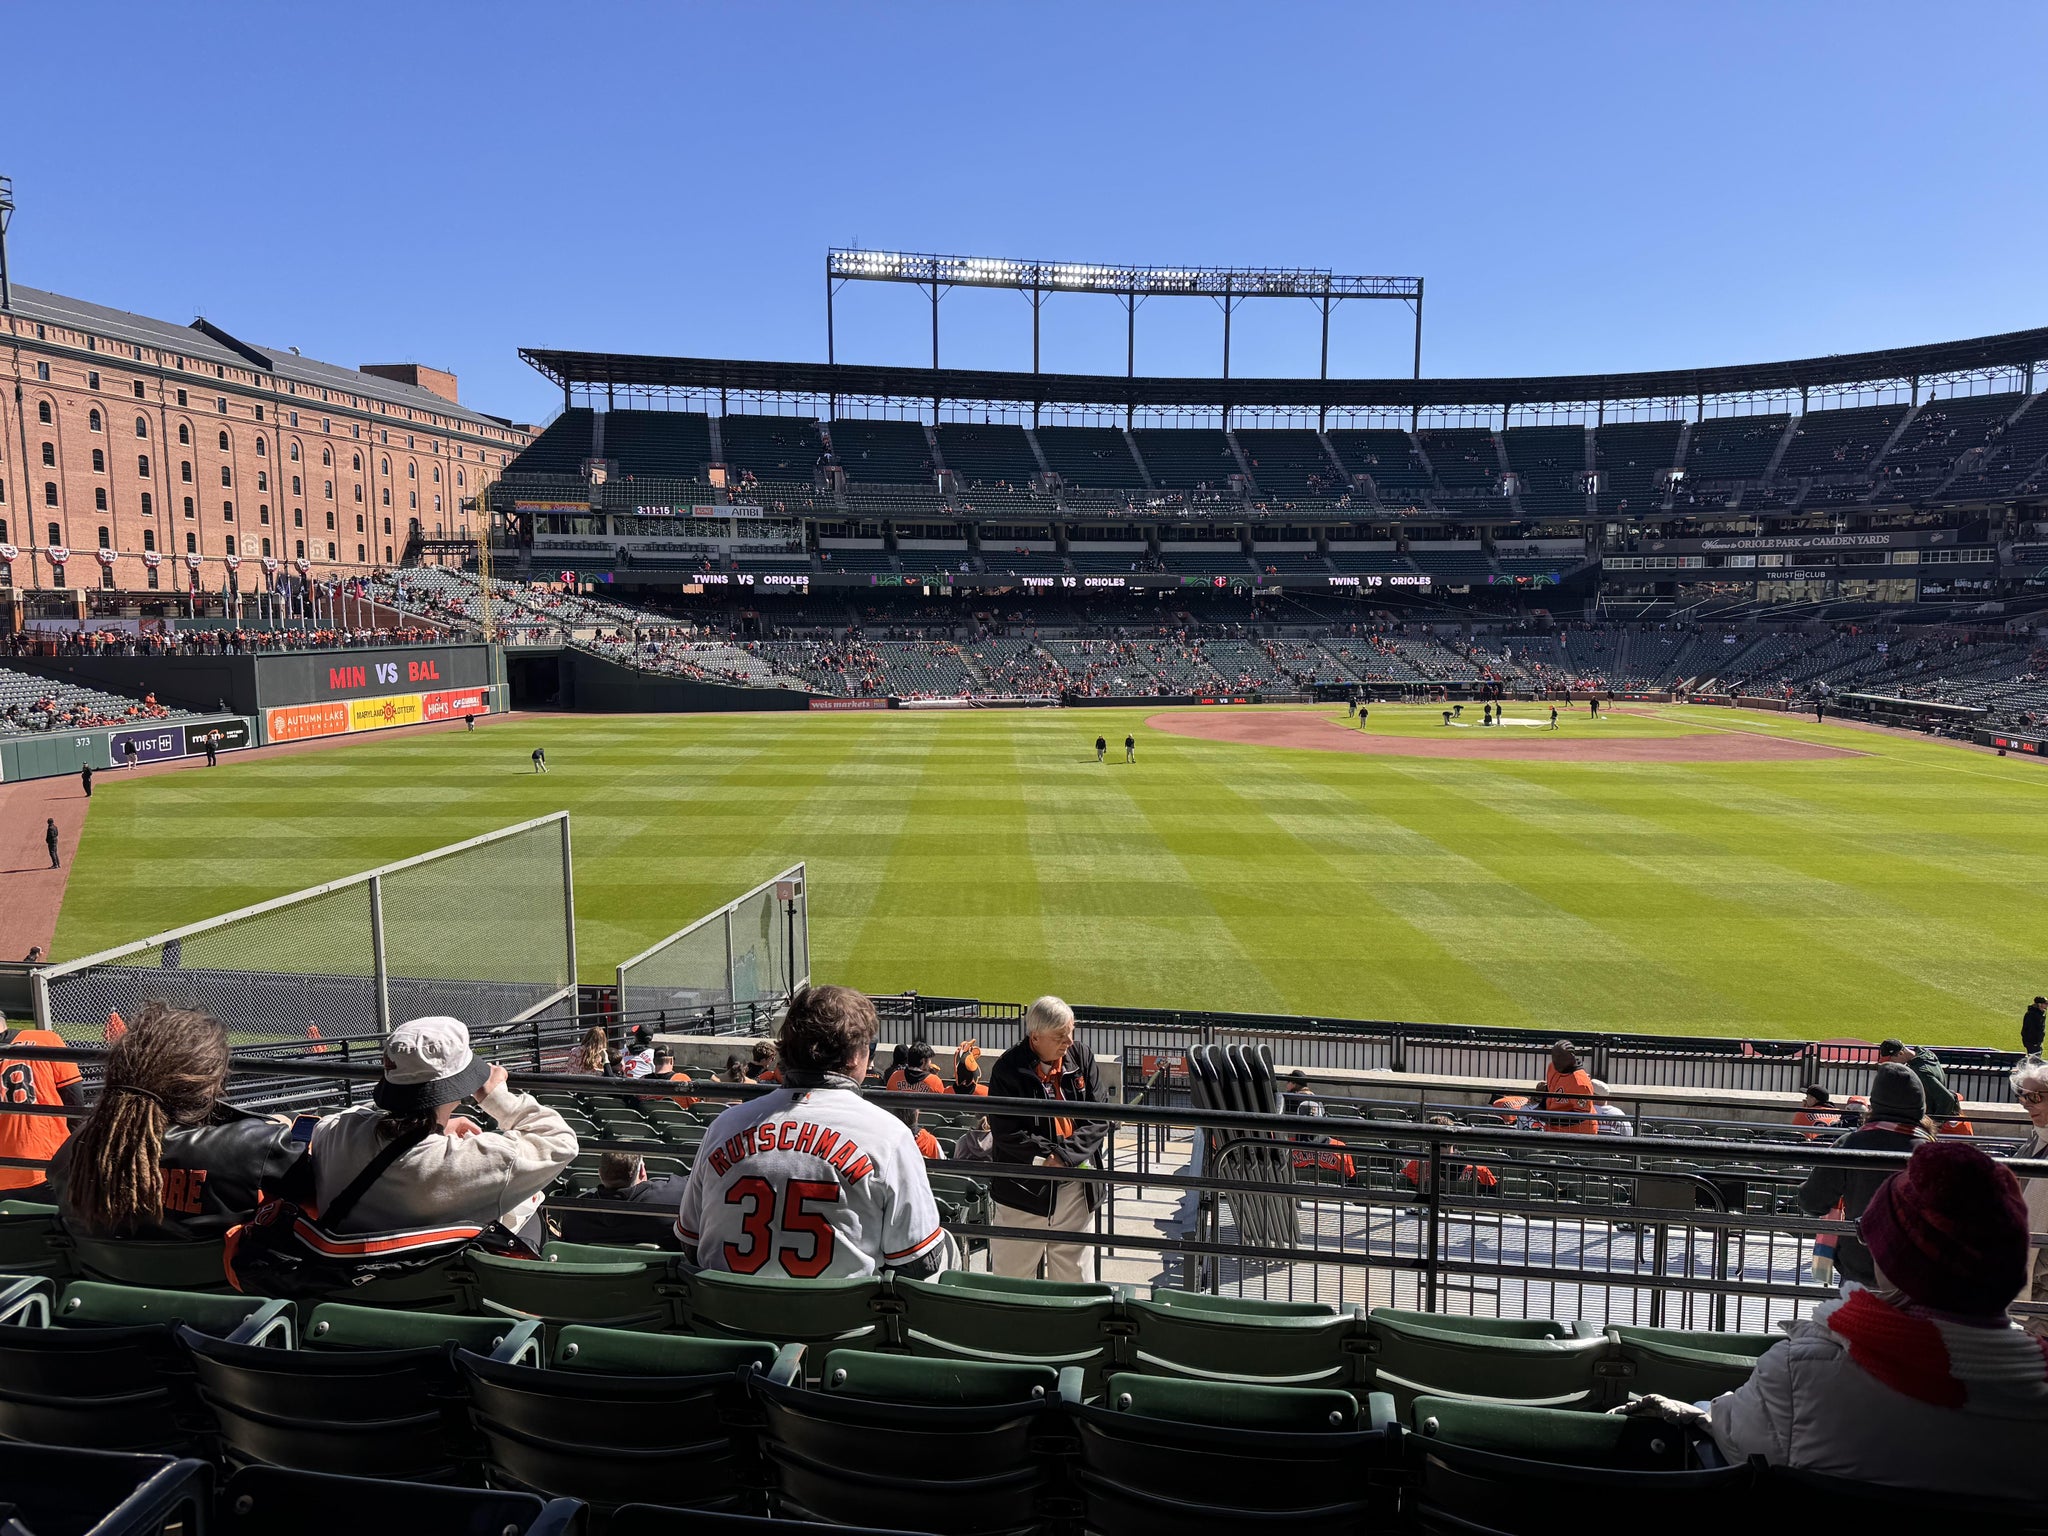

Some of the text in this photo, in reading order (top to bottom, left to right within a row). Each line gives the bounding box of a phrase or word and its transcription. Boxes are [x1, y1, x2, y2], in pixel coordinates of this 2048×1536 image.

[637, 505, 670, 514] 3:11:15
[731, 508, 759, 516] AMBI
[1737, 540, 1775, 548] ORIOLE
[1775, 539, 1802, 547] PARK
[1812, 537, 1856, 546] CAMDEN
[1857, 535, 1890, 544] YARDS
[693, 574, 810, 585] TWINS VS ORIOLES
[1022, 577, 1126, 587] TWINS VS ORIOLES
[1328, 576, 1432, 586] TWINS VS ORIOLES
[329, 659, 440, 690] MIN VS BAL
[811, 701, 832, 709] weis
[833, 700, 870, 709] markets
[356, 704, 416, 720] MARYLAND LOTTERY
[287, 710, 344, 726] AUTUMN LAKE
[287, 721, 345, 733] HEALTHCARE
[75, 737, 91, 748] 373
[120, 738, 157, 753] TUIST
[2011, 740, 2019, 748] VS
[708, 1121, 875, 1186] RUTSCHMAN
[723, 1175, 840, 1279] 35
